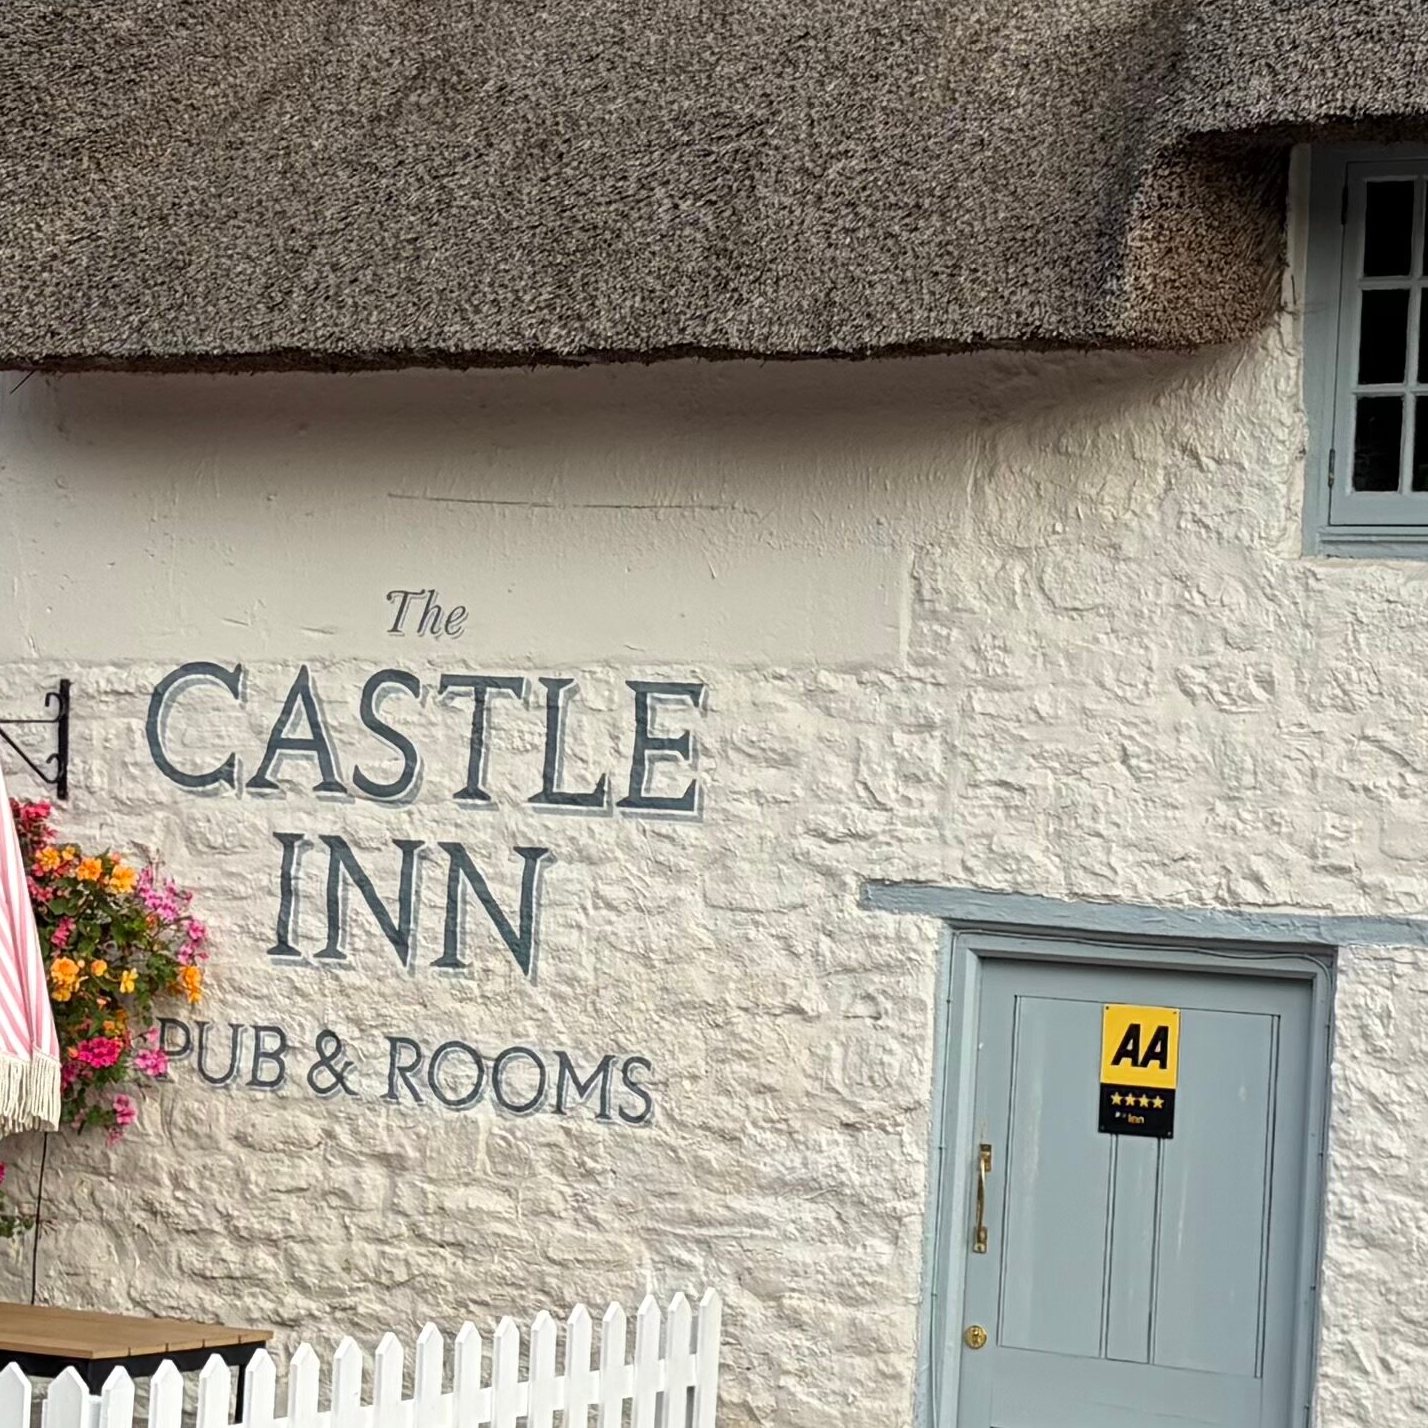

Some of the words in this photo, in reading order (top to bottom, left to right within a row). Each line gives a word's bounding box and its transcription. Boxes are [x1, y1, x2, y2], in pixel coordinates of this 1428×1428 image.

[385, 589, 468, 637] The
[145, 661, 709, 820] CASTLE
[266, 831, 559, 984] INN
[156, 1018, 289, 1090] PUB
[307, 1028, 359, 1097] &
[378, 1035, 655, 1128] ROOMS
[1110, 1022, 1170, 1070] AA
